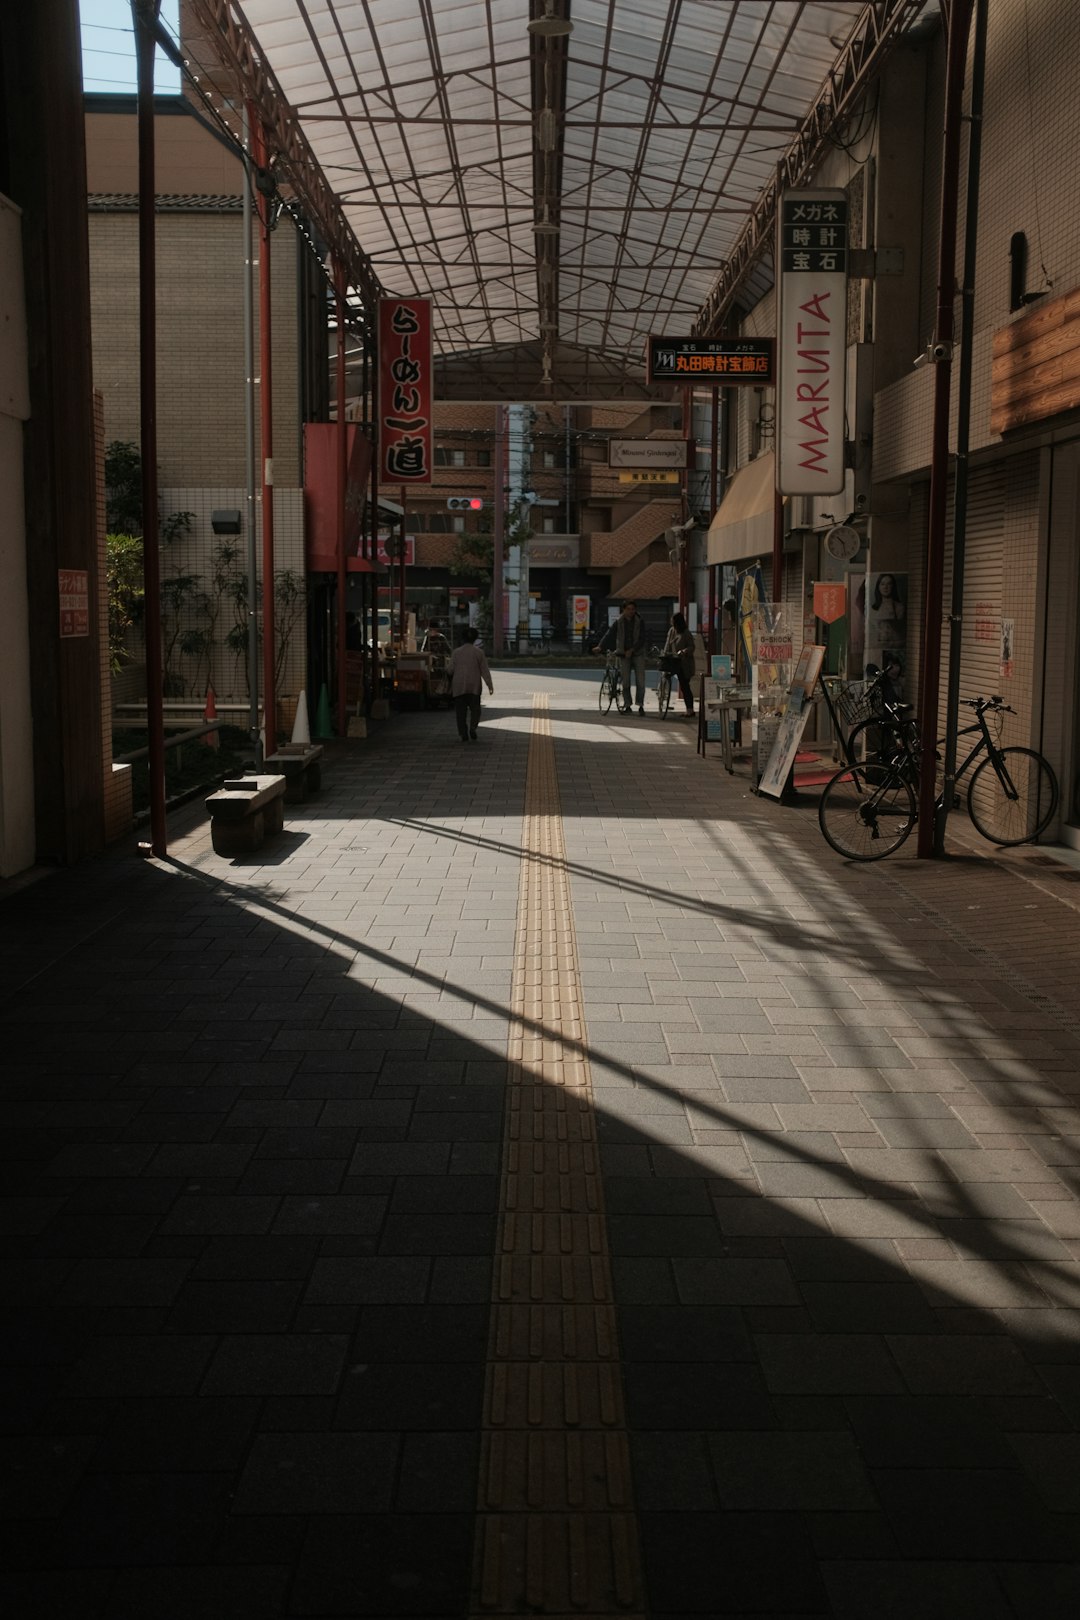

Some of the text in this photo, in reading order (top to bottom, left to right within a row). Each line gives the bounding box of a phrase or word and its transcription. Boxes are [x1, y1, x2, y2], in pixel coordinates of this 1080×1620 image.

[792, 204, 839, 221] メガネ
[792, 228, 838, 247] 時計
[792, 252, 838, 271] 宝石
[708, 344, 722, 352] 時計
[735, 344, 755, 352] メガネ
[676, 355, 769, 372] 丸田時計宝飾店
[384, 304, 428, 478] らーめん一道
[796, 292, 831, 474] MARUTA
